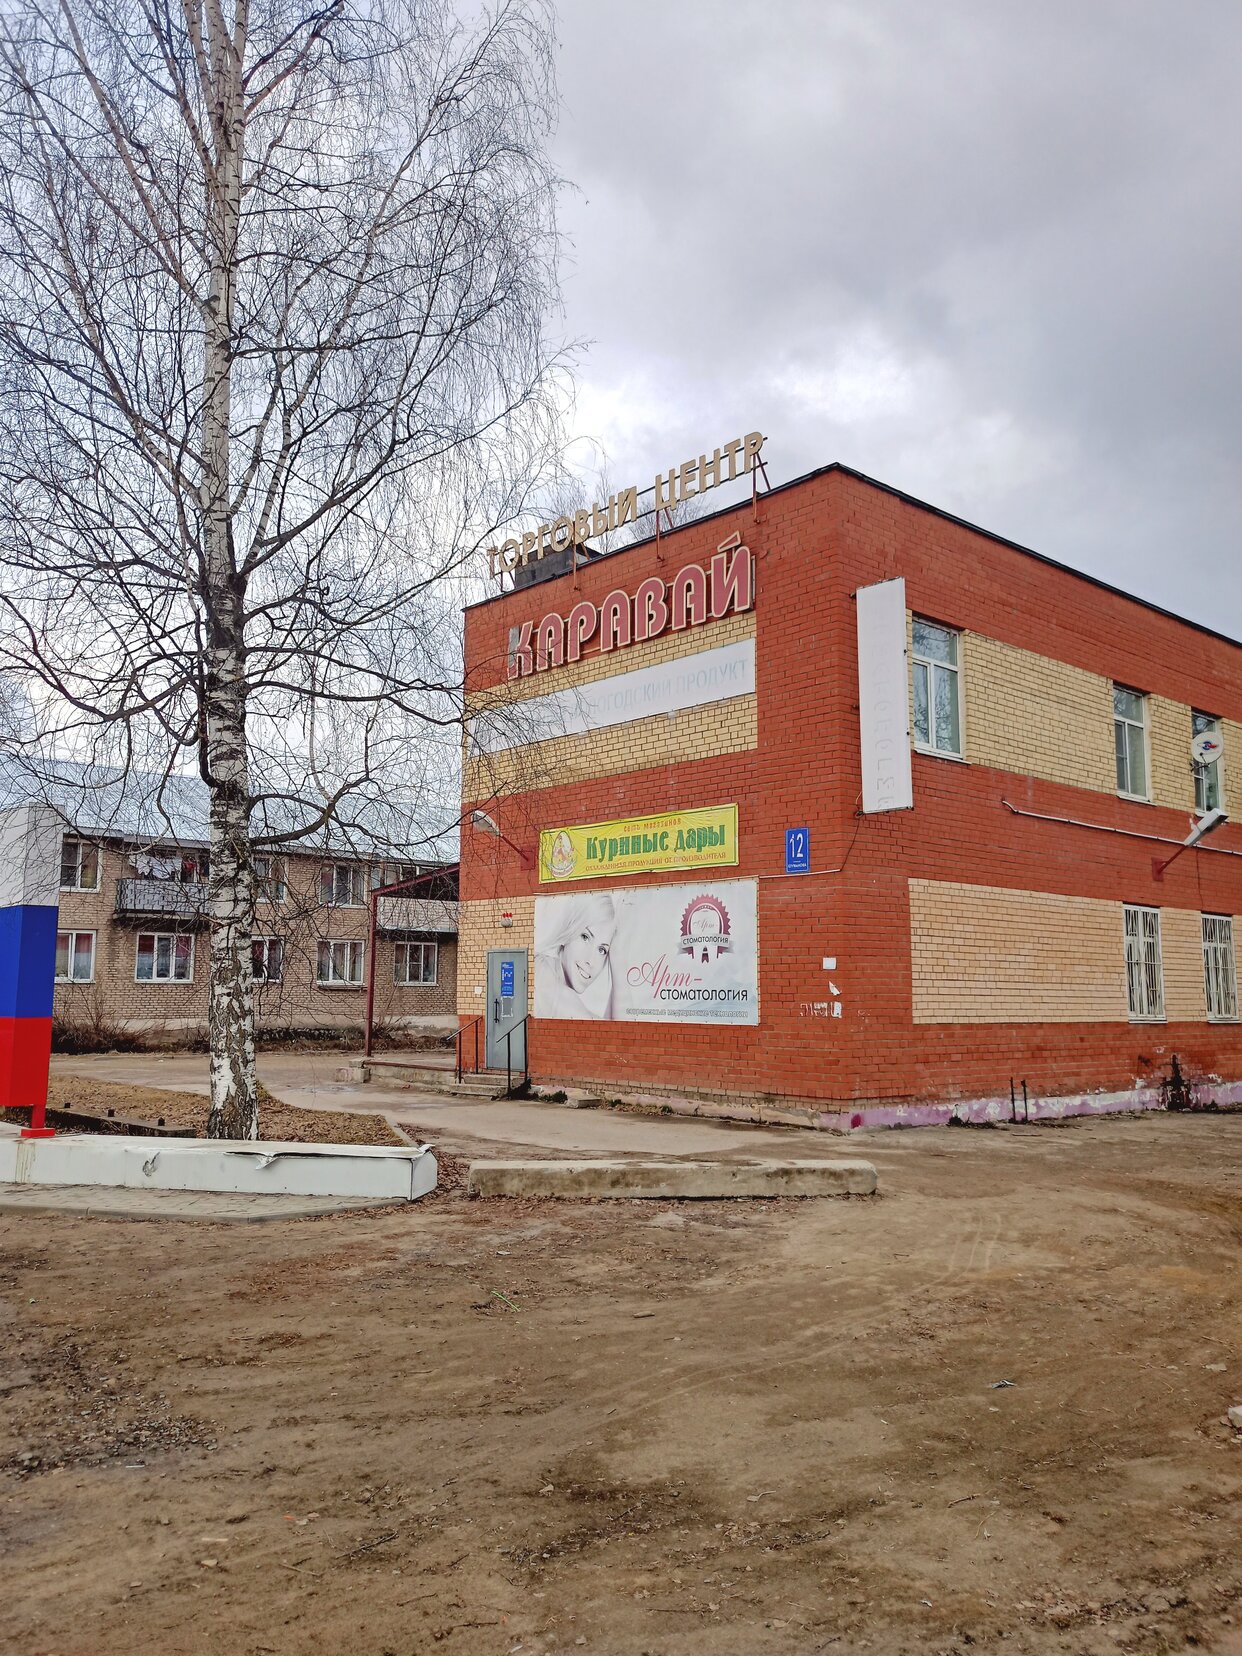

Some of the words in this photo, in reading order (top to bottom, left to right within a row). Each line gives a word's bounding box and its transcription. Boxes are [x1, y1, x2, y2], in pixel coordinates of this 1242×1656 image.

[486, 486, 638, 581] ТОРГОВЫЙ
[655, 431, 764, 512] ЦЕНТР
[506, 530, 755, 682] КАРАВАЙ
[677, 660, 749, 694] ПРОДУКТ
[587, 831, 669, 862] Куриные
[789, 832, 804, 858] 12
